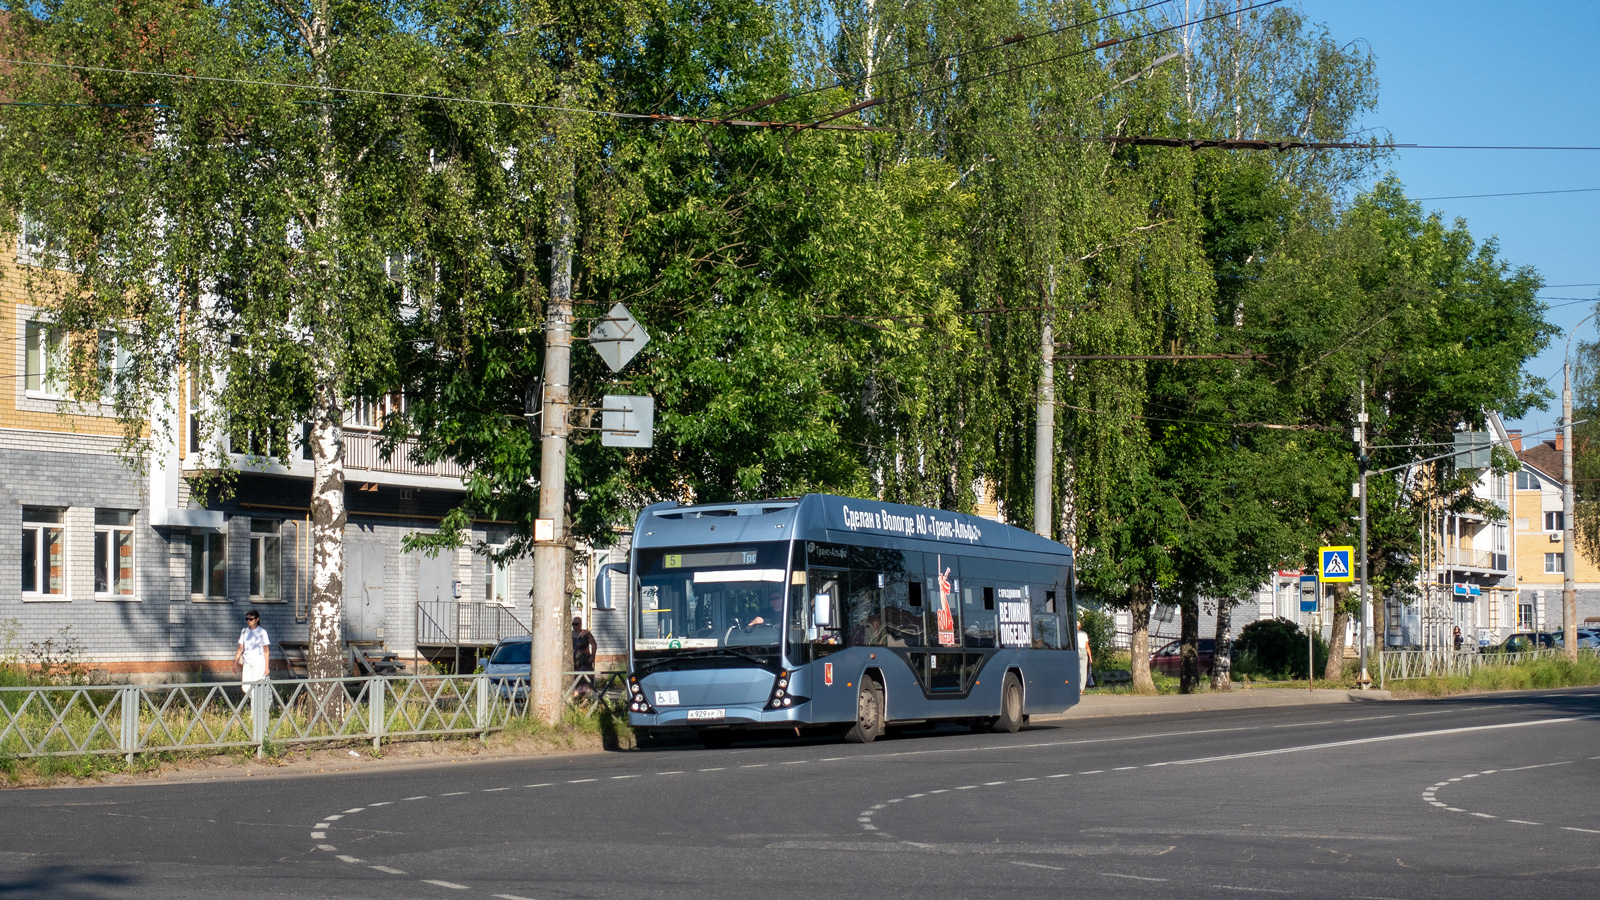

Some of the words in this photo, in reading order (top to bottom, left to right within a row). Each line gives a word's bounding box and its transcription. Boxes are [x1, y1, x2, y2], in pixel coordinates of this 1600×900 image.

[843, 505, 875, 531] Сделан
[875, 513, 881, 529] в
[881, 509, 915, 536] Вологде
[916, 514, 927, 535] АО
[927, 515, 982, 543] «Транс-Альфа»
[669, 555, 676, 567] 5
[999, 599, 1030, 622] ВЕЛИКОЙ
[672, 641, 678, 649] 5
[1000, 624, 1031, 648] ПОБЕДЫ!
